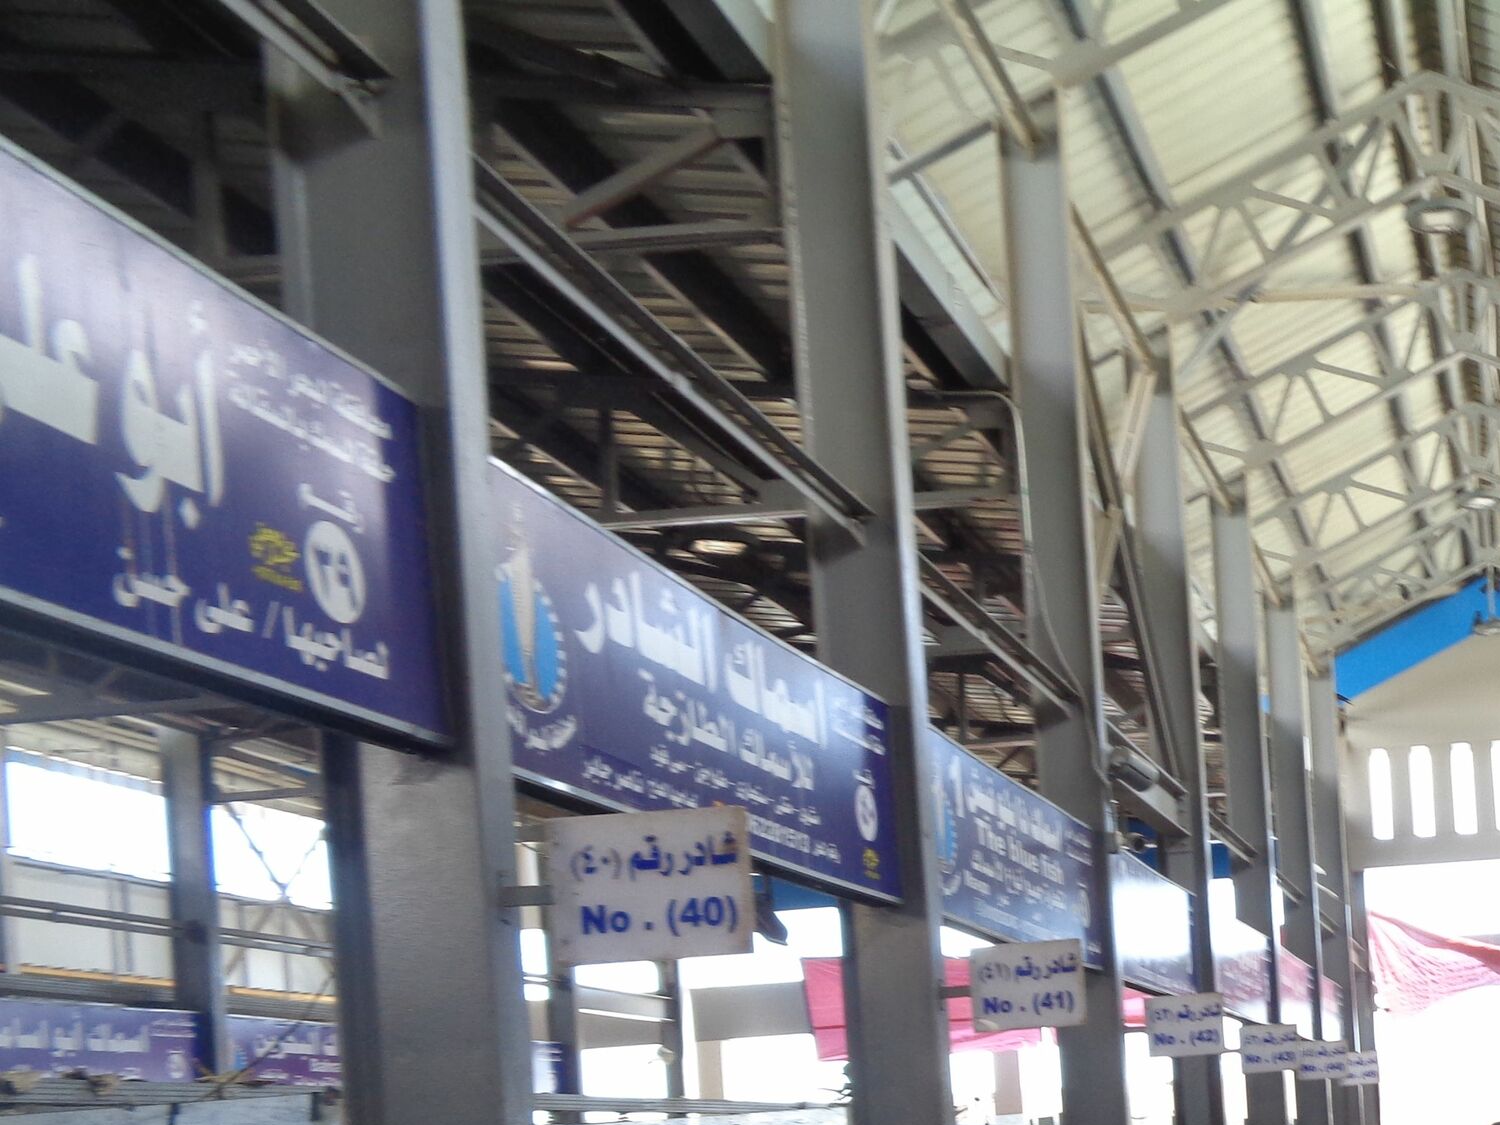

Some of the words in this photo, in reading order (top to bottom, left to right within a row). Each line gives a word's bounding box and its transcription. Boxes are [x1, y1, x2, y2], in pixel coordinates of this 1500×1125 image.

[114, 300, 224, 524] أبو
[628, 834, 674, 882] رقم
[679, 831, 738, 877] شادر
[973, 815, 1007, 857] The
[667, 895, 738, 938] (40)
[1031, 989, 1075, 1016] (41)
